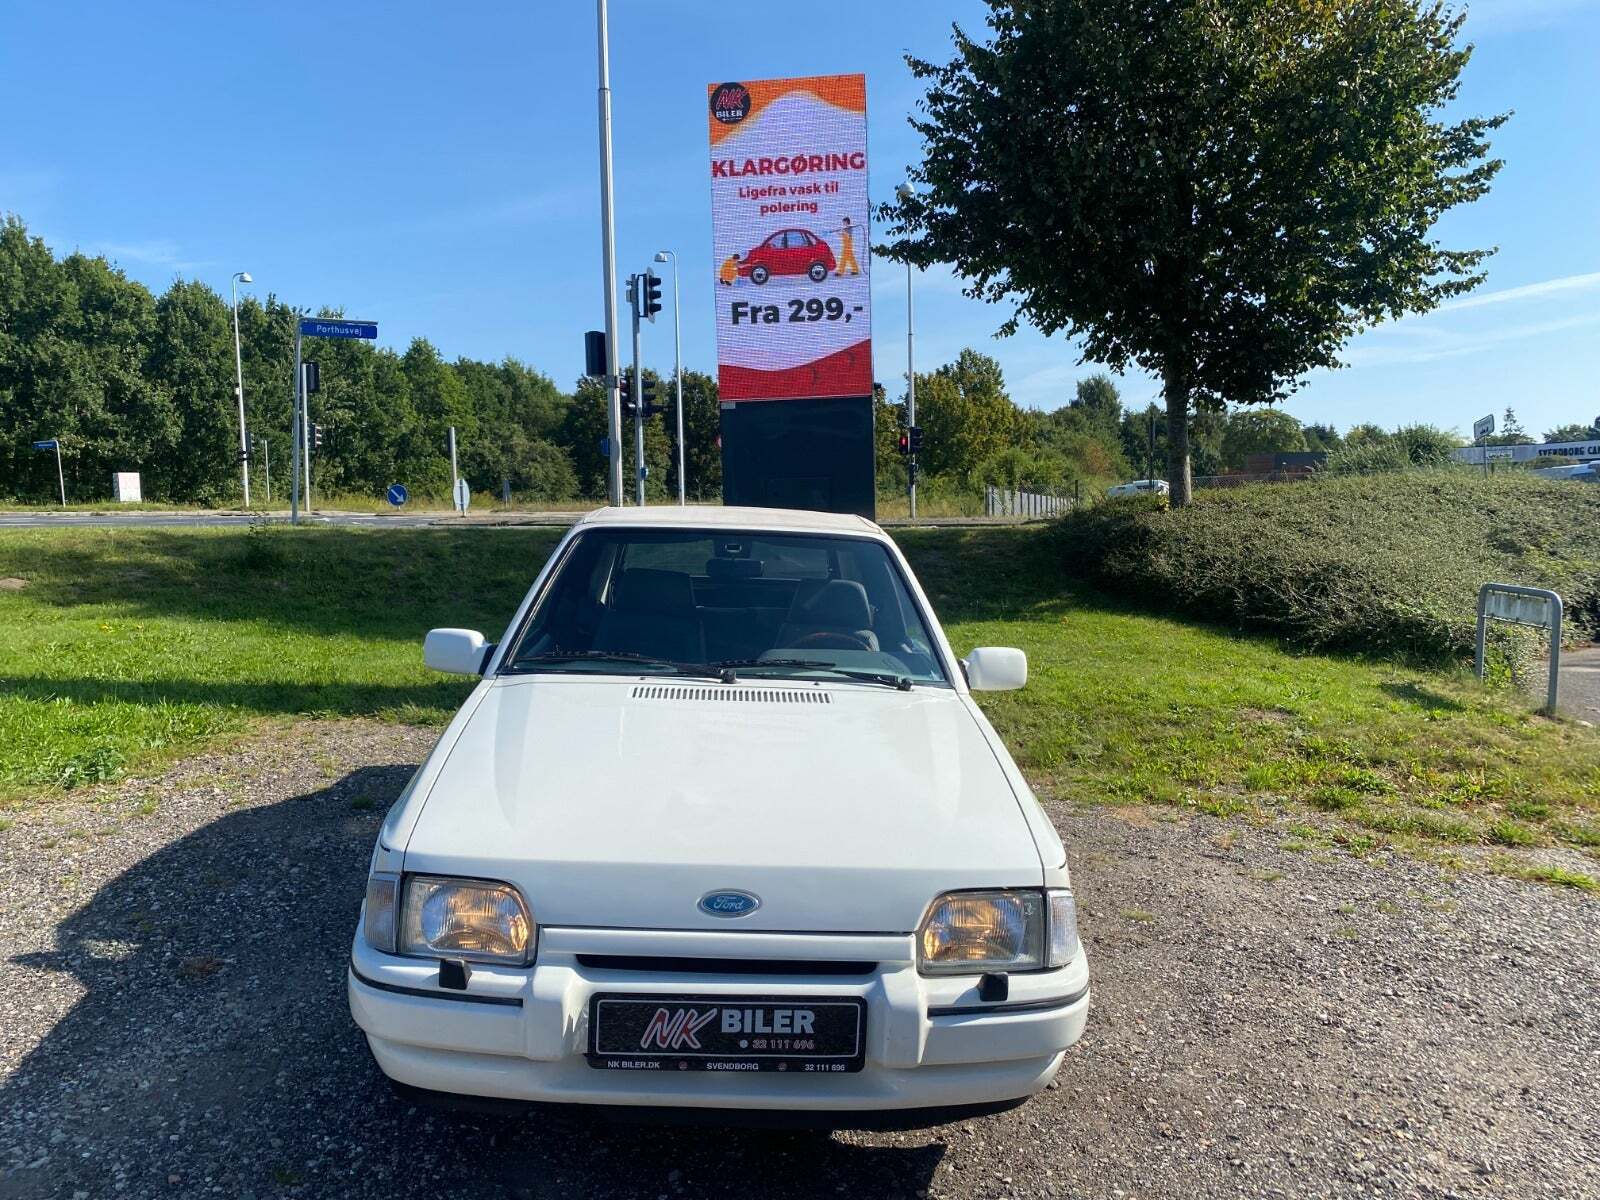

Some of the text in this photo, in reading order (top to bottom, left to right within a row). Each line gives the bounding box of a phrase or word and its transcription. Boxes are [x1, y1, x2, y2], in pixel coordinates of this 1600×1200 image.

[716, 88, 748, 110] NK
[716, 110, 743, 118] BILER
[712, 152, 865, 178] KLARGØRING
[739, 181, 839, 200] Ligefra vask til
[760, 201, 818, 216] polering
[731, 297, 863, 325] Fra 299,-
[316, 324, 362, 336] Porthusvej
[713, 895, 745, 910] Ford
[640, 1007, 816, 1050] NK BILER
[752, 1039, 815, 1050] 32 111 696
[607, 1060, 660, 1069] NK BILER.DK
[706, 1062, 759, 1071] SVENDBORG
[804, 1063, 845, 1072] 32 111 696
